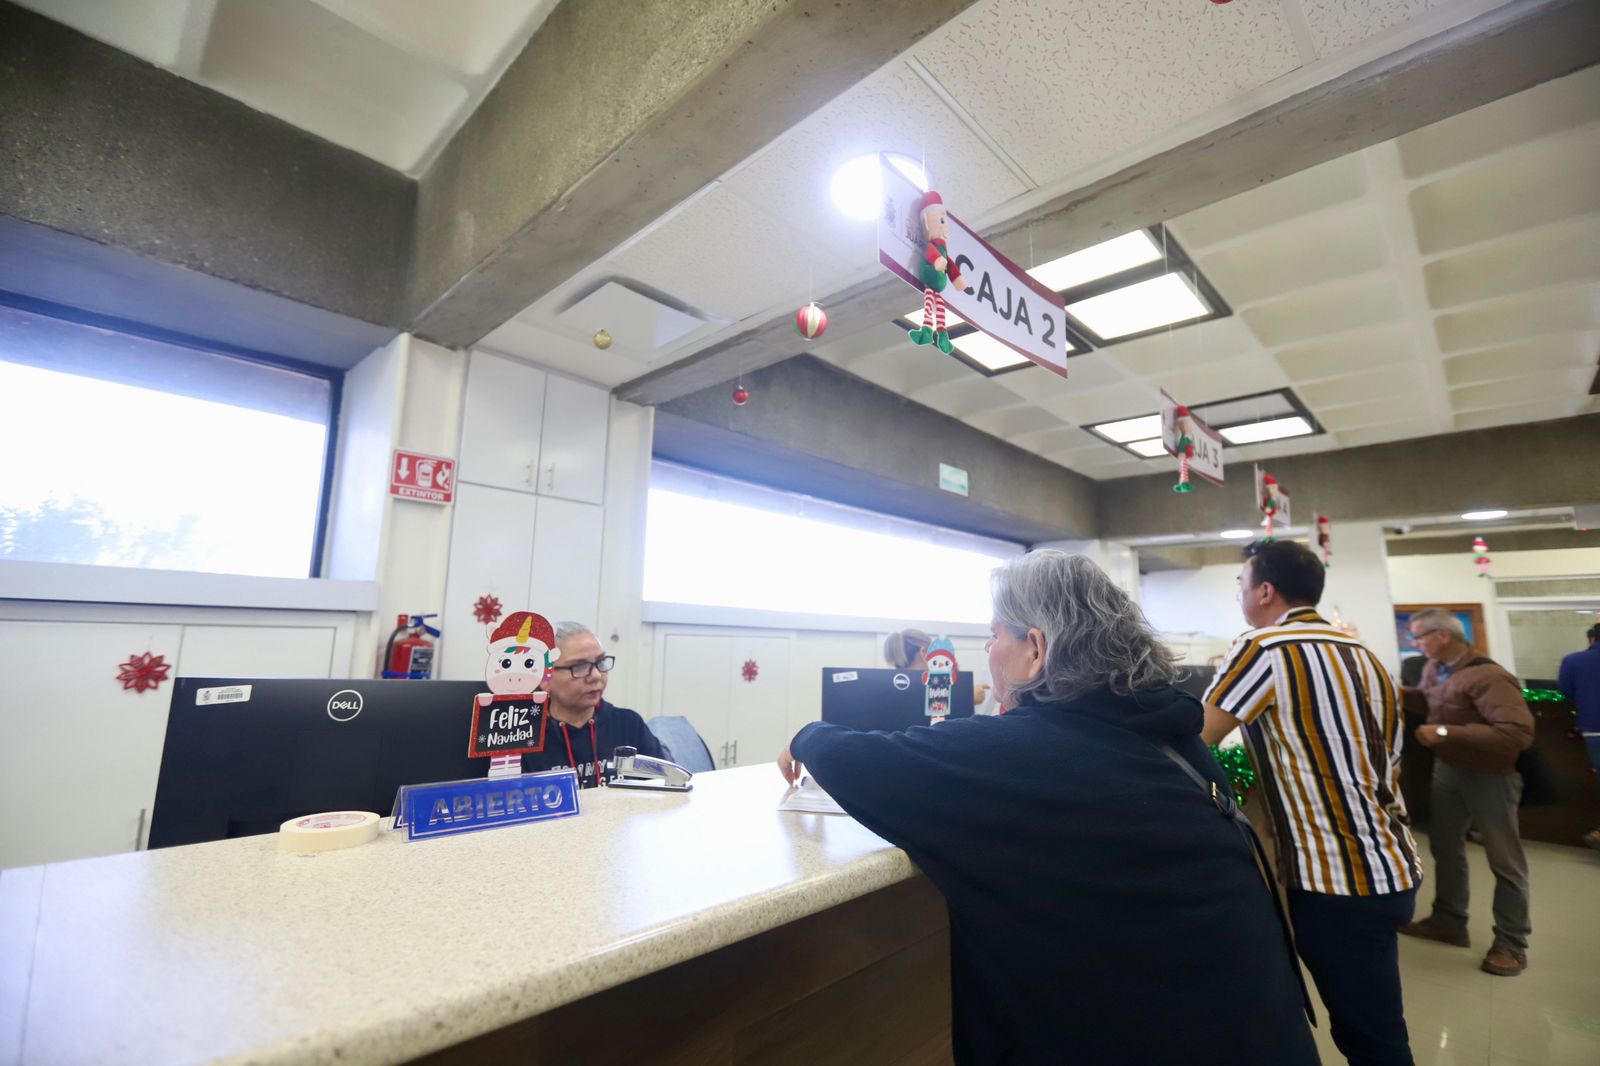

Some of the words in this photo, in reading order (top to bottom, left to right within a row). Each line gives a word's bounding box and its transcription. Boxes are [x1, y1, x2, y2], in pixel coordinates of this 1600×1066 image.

[1041, 312, 1056, 349] 2
[1212, 447, 1219, 468] 3
[398, 487, 445, 501] EXTINTOR
[331, 700, 359, 710] DELL
[489, 705, 530, 730] Feliz
[487, 724, 534, 748] Navidad
[428, 784, 564, 826] ABIERTO
